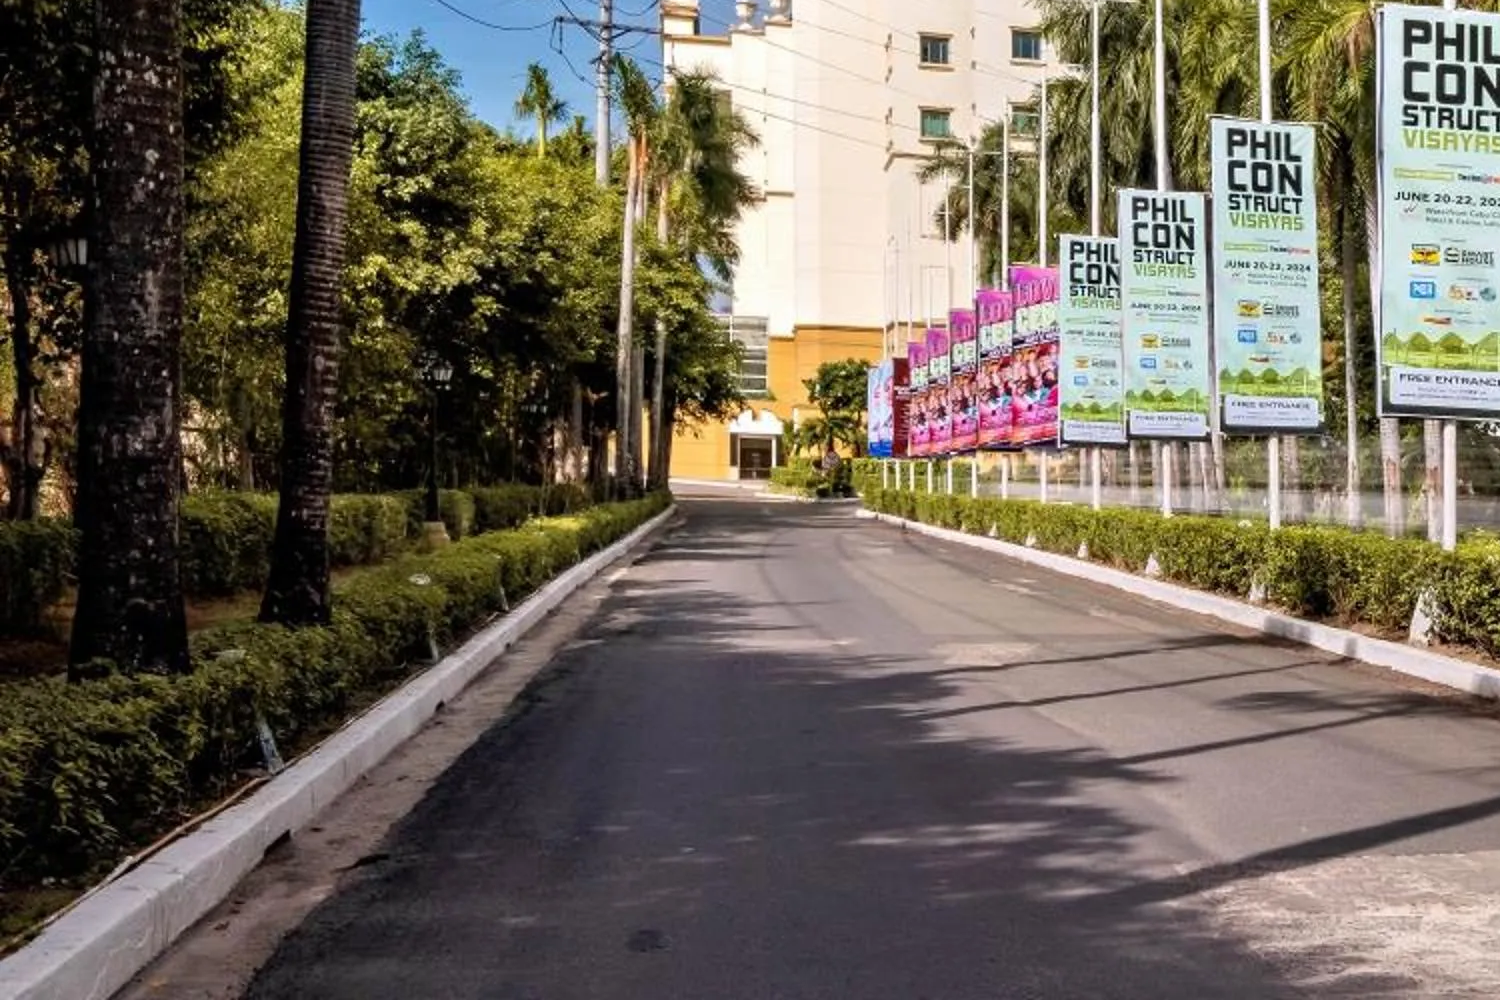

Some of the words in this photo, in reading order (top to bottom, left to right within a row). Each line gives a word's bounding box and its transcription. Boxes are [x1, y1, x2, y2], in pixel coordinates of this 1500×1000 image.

[1227, 128, 1302, 162] PHIL
[1228, 160, 1302, 196] CON
[1228, 194, 1302, 214] STRUCT
[1394, 191, 1428, 203] JUNE
[1131, 197, 1194, 223] PHIL
[1229, 212, 1303, 231] VISAYAS
[1133, 223, 1195, 250] CON
[1069, 240, 1119, 264] PHIL
[1133, 249, 1195, 265] STRUCT
[1069, 262, 1120, 286] CON
